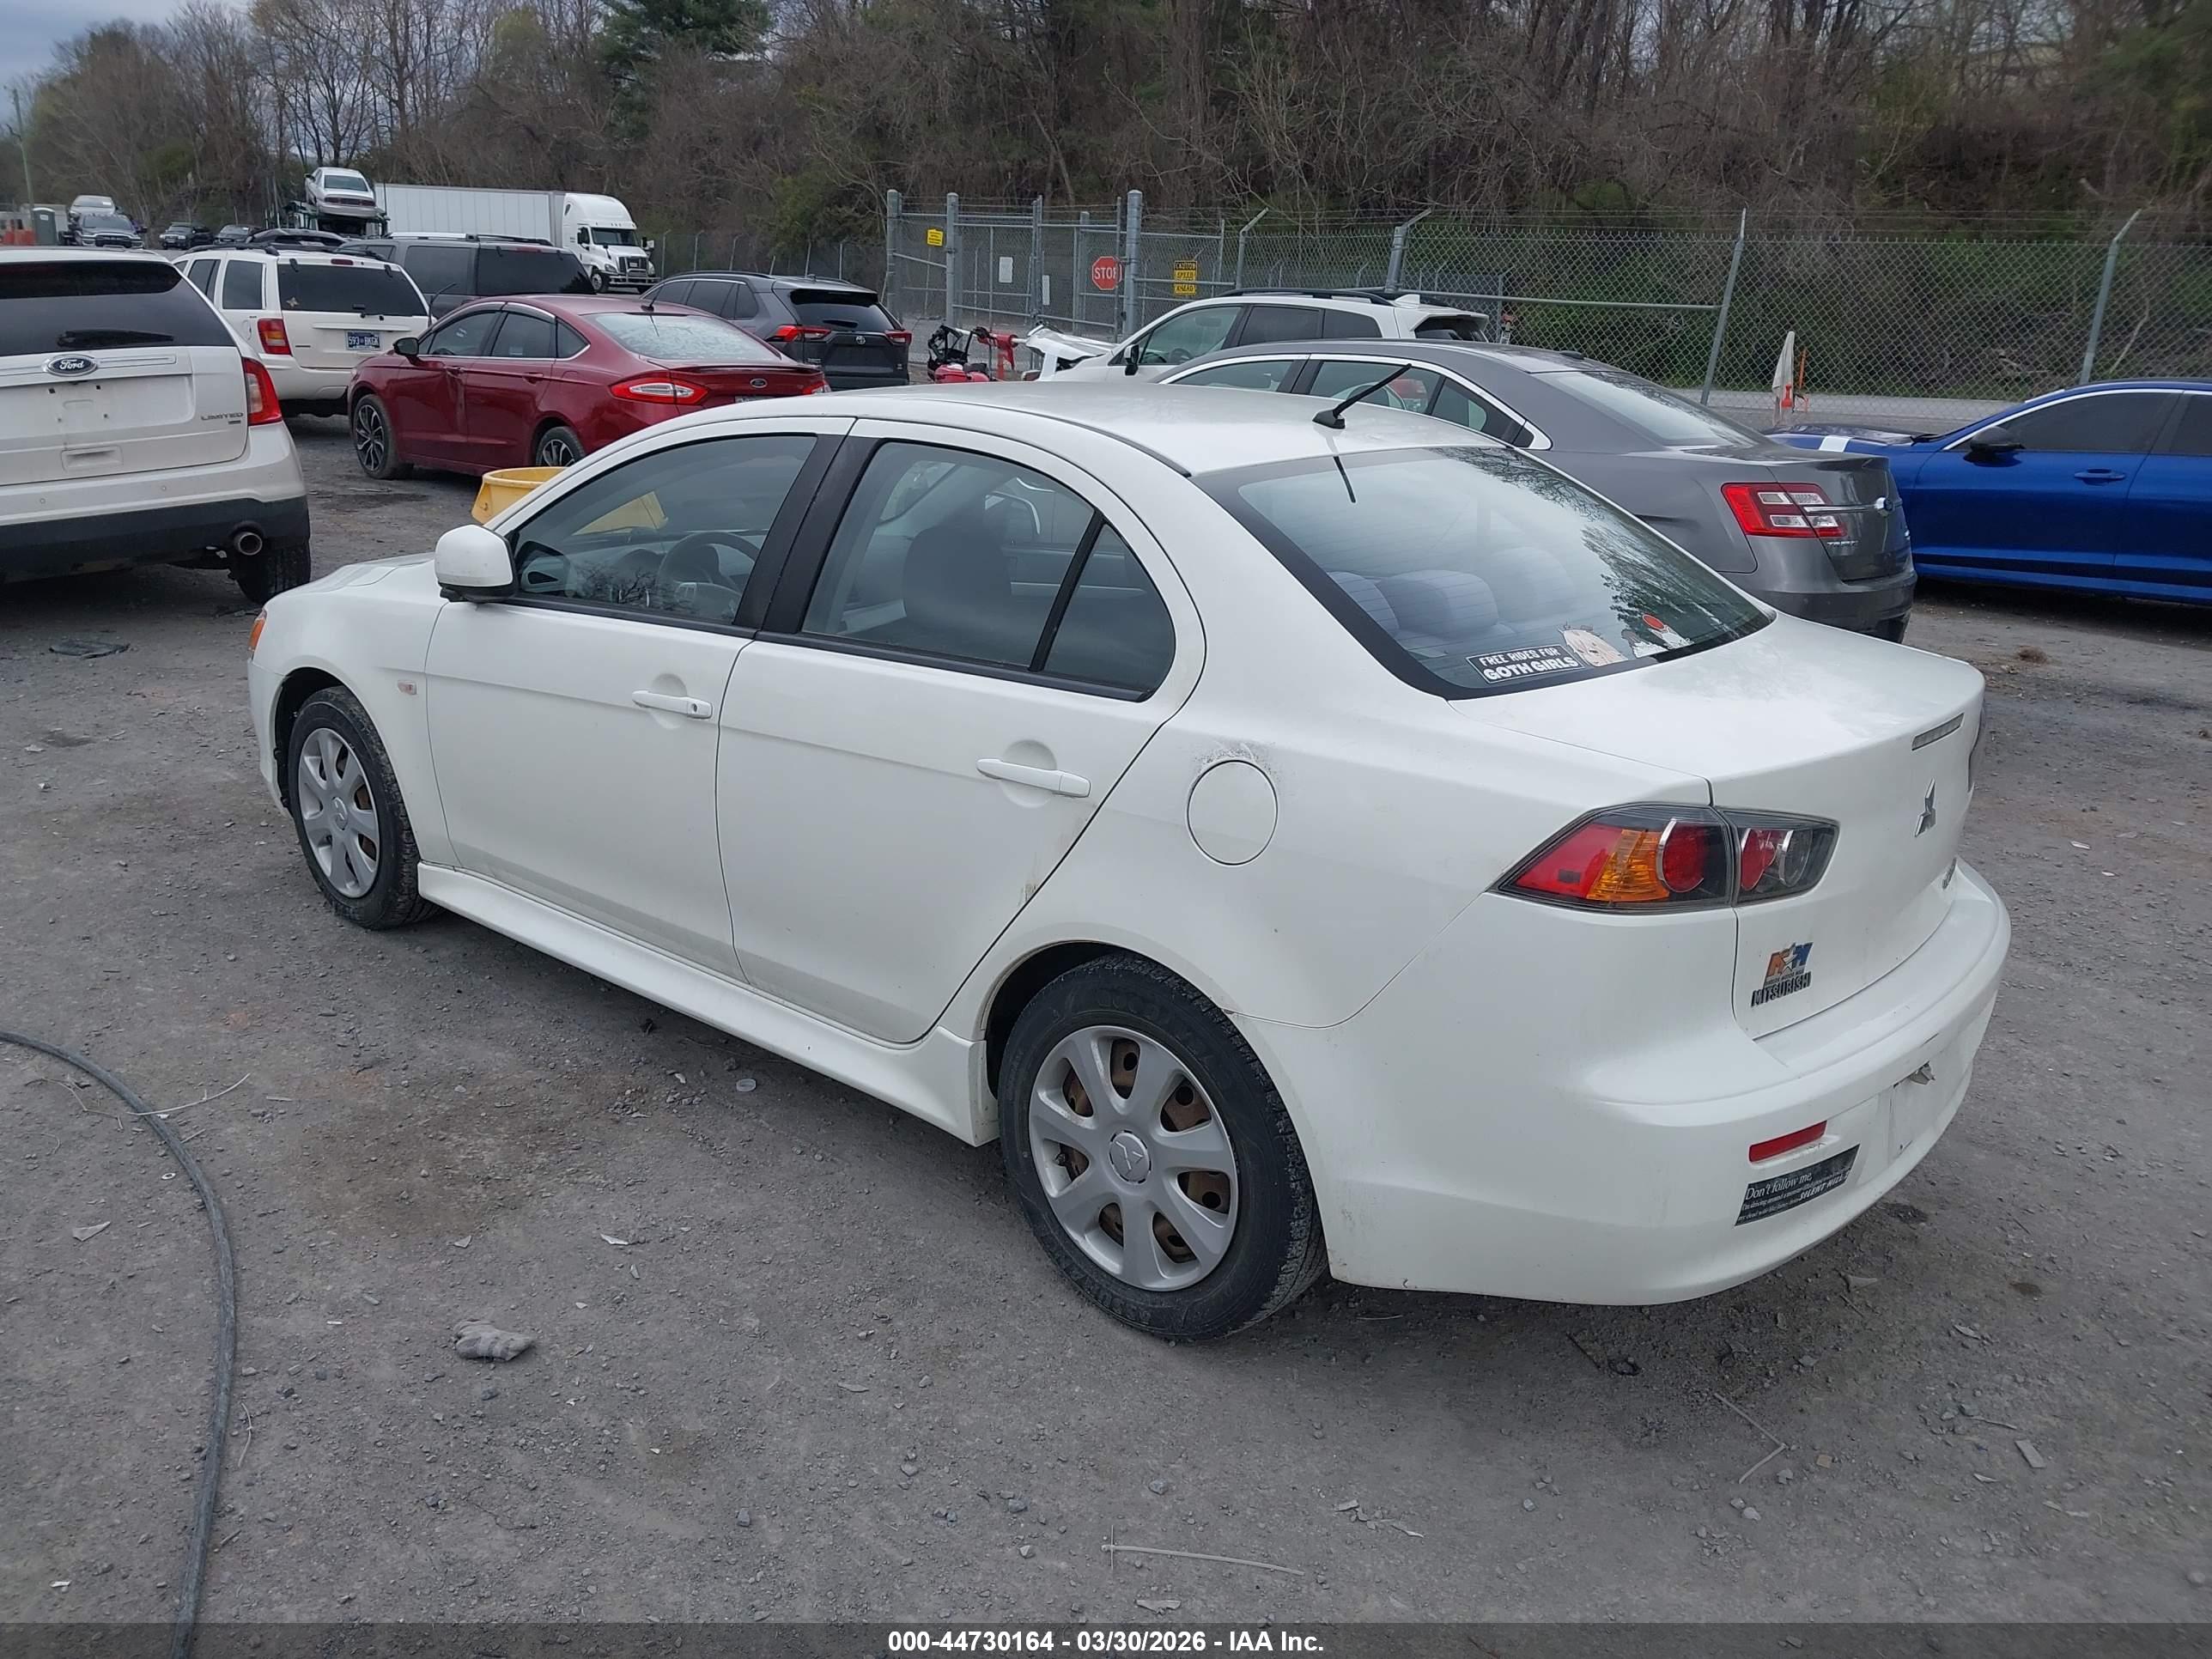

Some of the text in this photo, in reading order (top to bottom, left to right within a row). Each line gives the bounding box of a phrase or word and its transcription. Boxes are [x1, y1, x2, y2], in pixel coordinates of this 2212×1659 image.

[349, 336, 360, 345] 593
[59, 359, 84, 370] Ford
[1479, 647, 1561, 667] FREE RIDES FOR
[1483, 657, 1579, 680] GOTH GIRLS
[1746, 1183, 1771, 1200] Don't
[1771, 1176, 1799, 1194] follow
